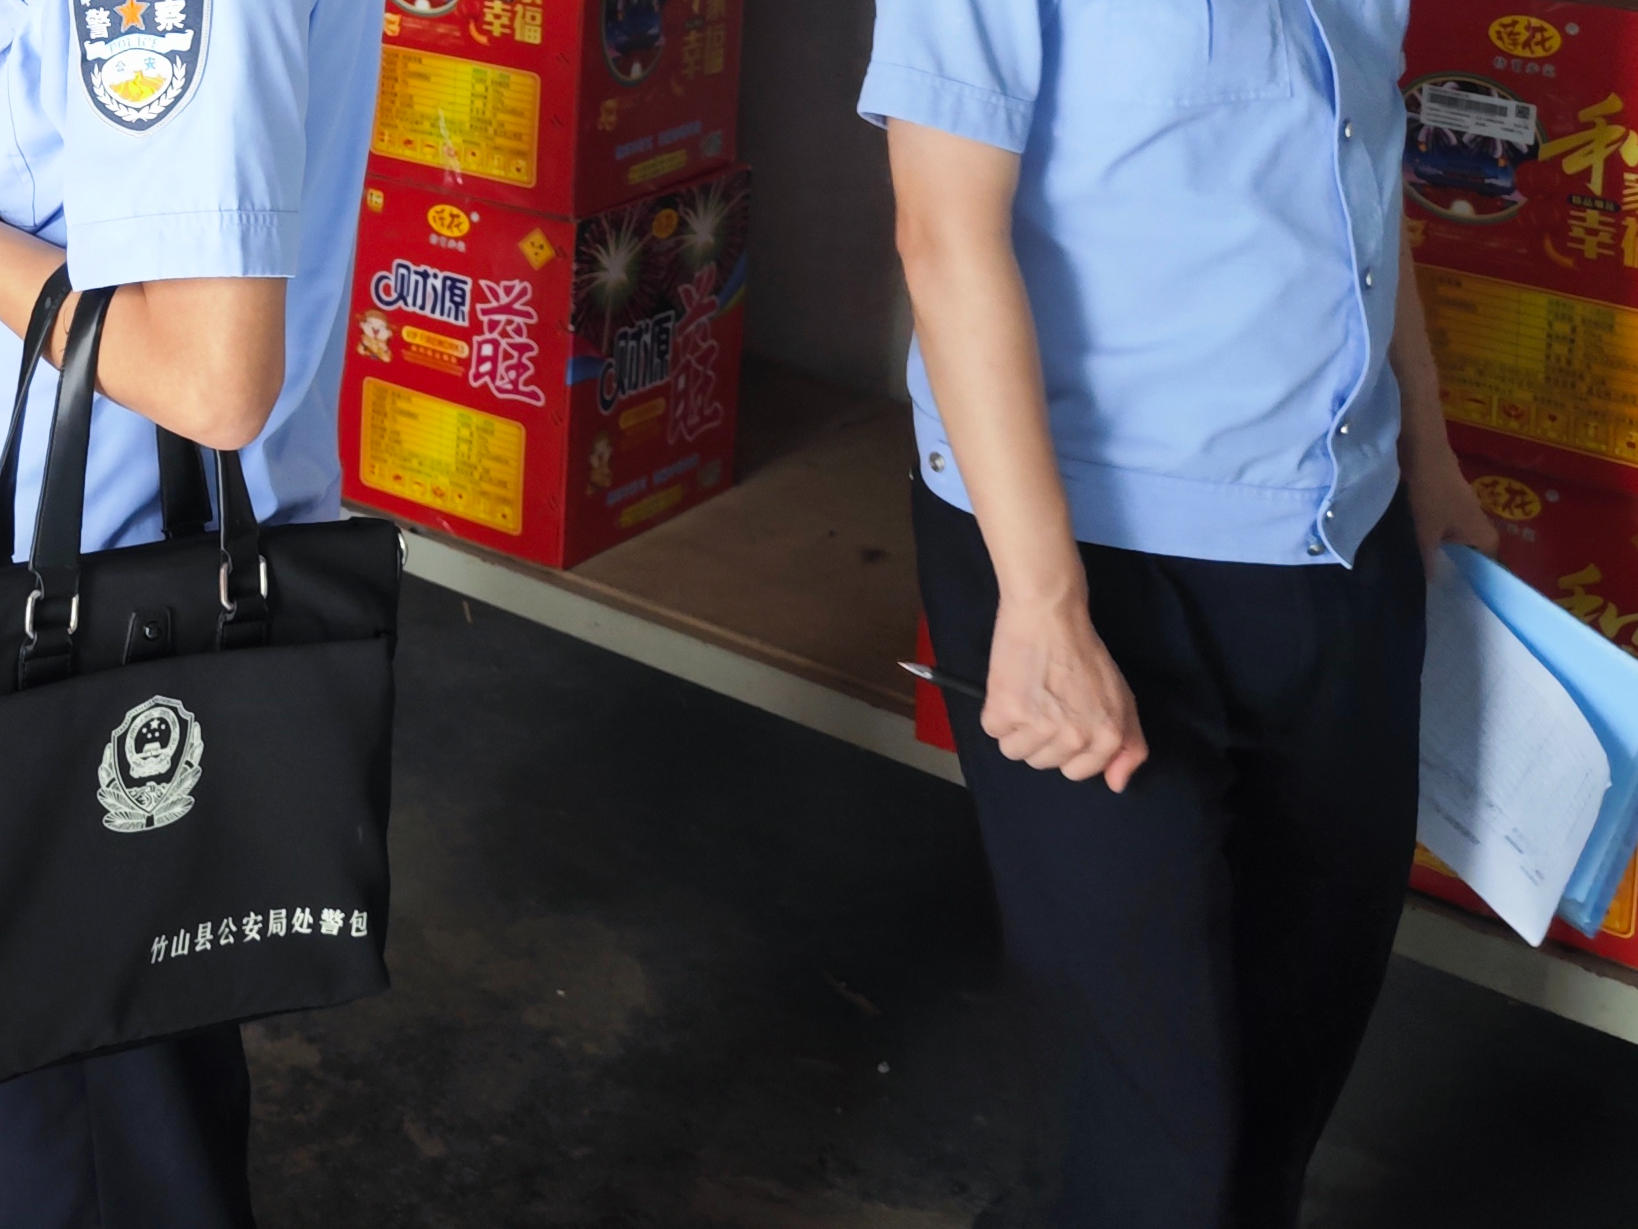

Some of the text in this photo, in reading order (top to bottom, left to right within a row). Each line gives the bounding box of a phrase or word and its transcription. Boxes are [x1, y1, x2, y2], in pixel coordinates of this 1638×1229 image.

[85, 7, 111, 39] 警
[1492, 18, 1557, 56] 莲花
[371, 259, 546, 408] 财源 兴旺
[596, 309, 677, 417] 财源
[150, 906, 368, 964] 竹山县公安局处警包
